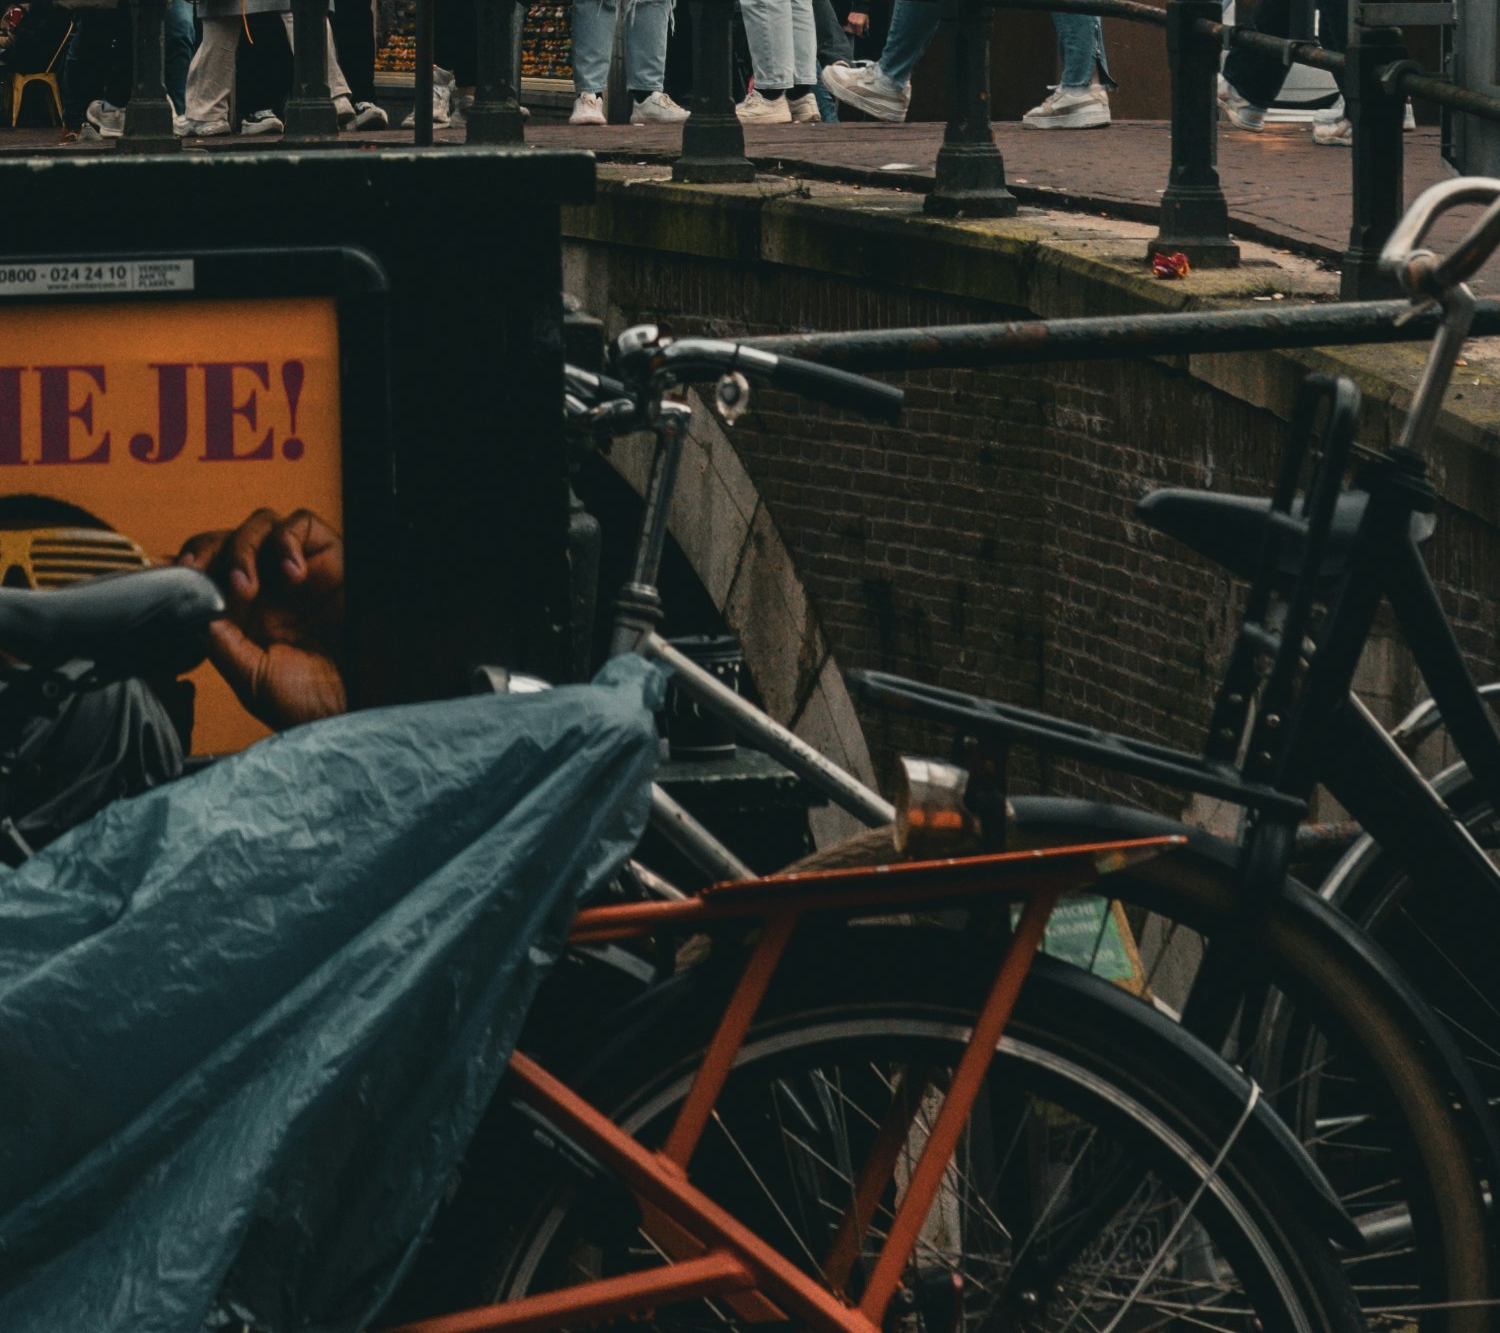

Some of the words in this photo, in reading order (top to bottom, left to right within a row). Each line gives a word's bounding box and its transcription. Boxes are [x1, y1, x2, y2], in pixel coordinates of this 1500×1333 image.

[51, 267, 79, 282] 024
[85, 266, 104, 281] 24
[109, 265, 126, 280] 10
[128, 361, 306, 465] JE!
